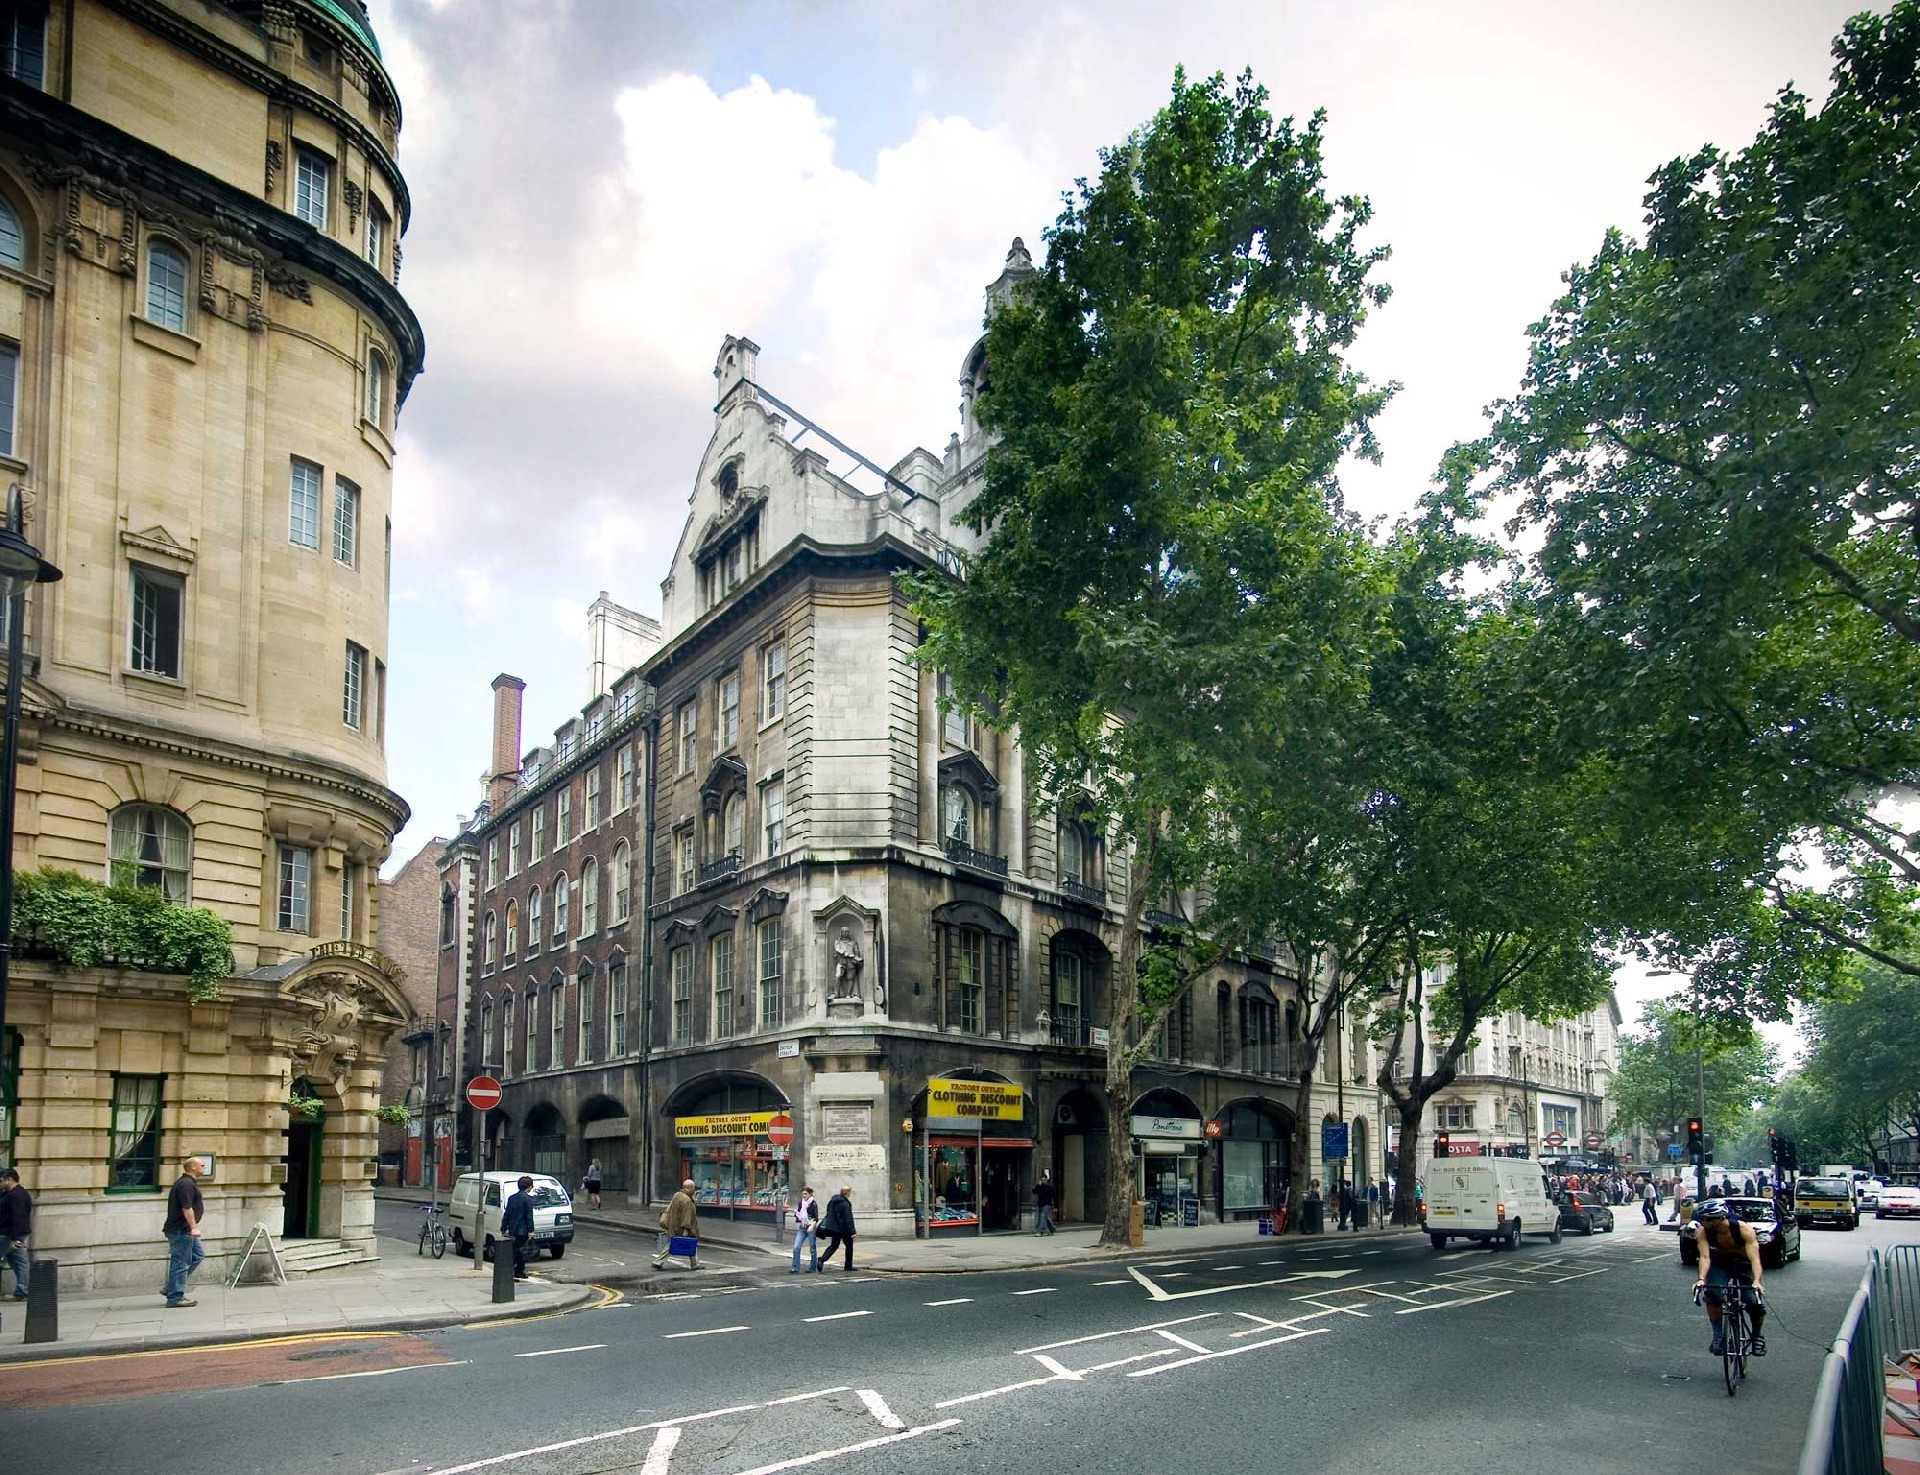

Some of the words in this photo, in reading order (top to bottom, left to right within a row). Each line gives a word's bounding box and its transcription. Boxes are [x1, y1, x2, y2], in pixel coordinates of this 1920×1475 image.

[951, 1084, 980, 1092] FACTORY
[933, 1091, 977, 1103] CLOTHING
[980, 1094, 1021, 1106] DISCOUNT
[957, 1104, 1000, 1116] COMPANY
[676, 1124, 710, 1135] CLOTHING
[711, 1122, 747, 1134] DISCOUNT
[749, 1121, 768, 1132] COM
[1206, 1123, 1220, 1135] illy
[1448, 1143, 1473, 1154] OSTA
